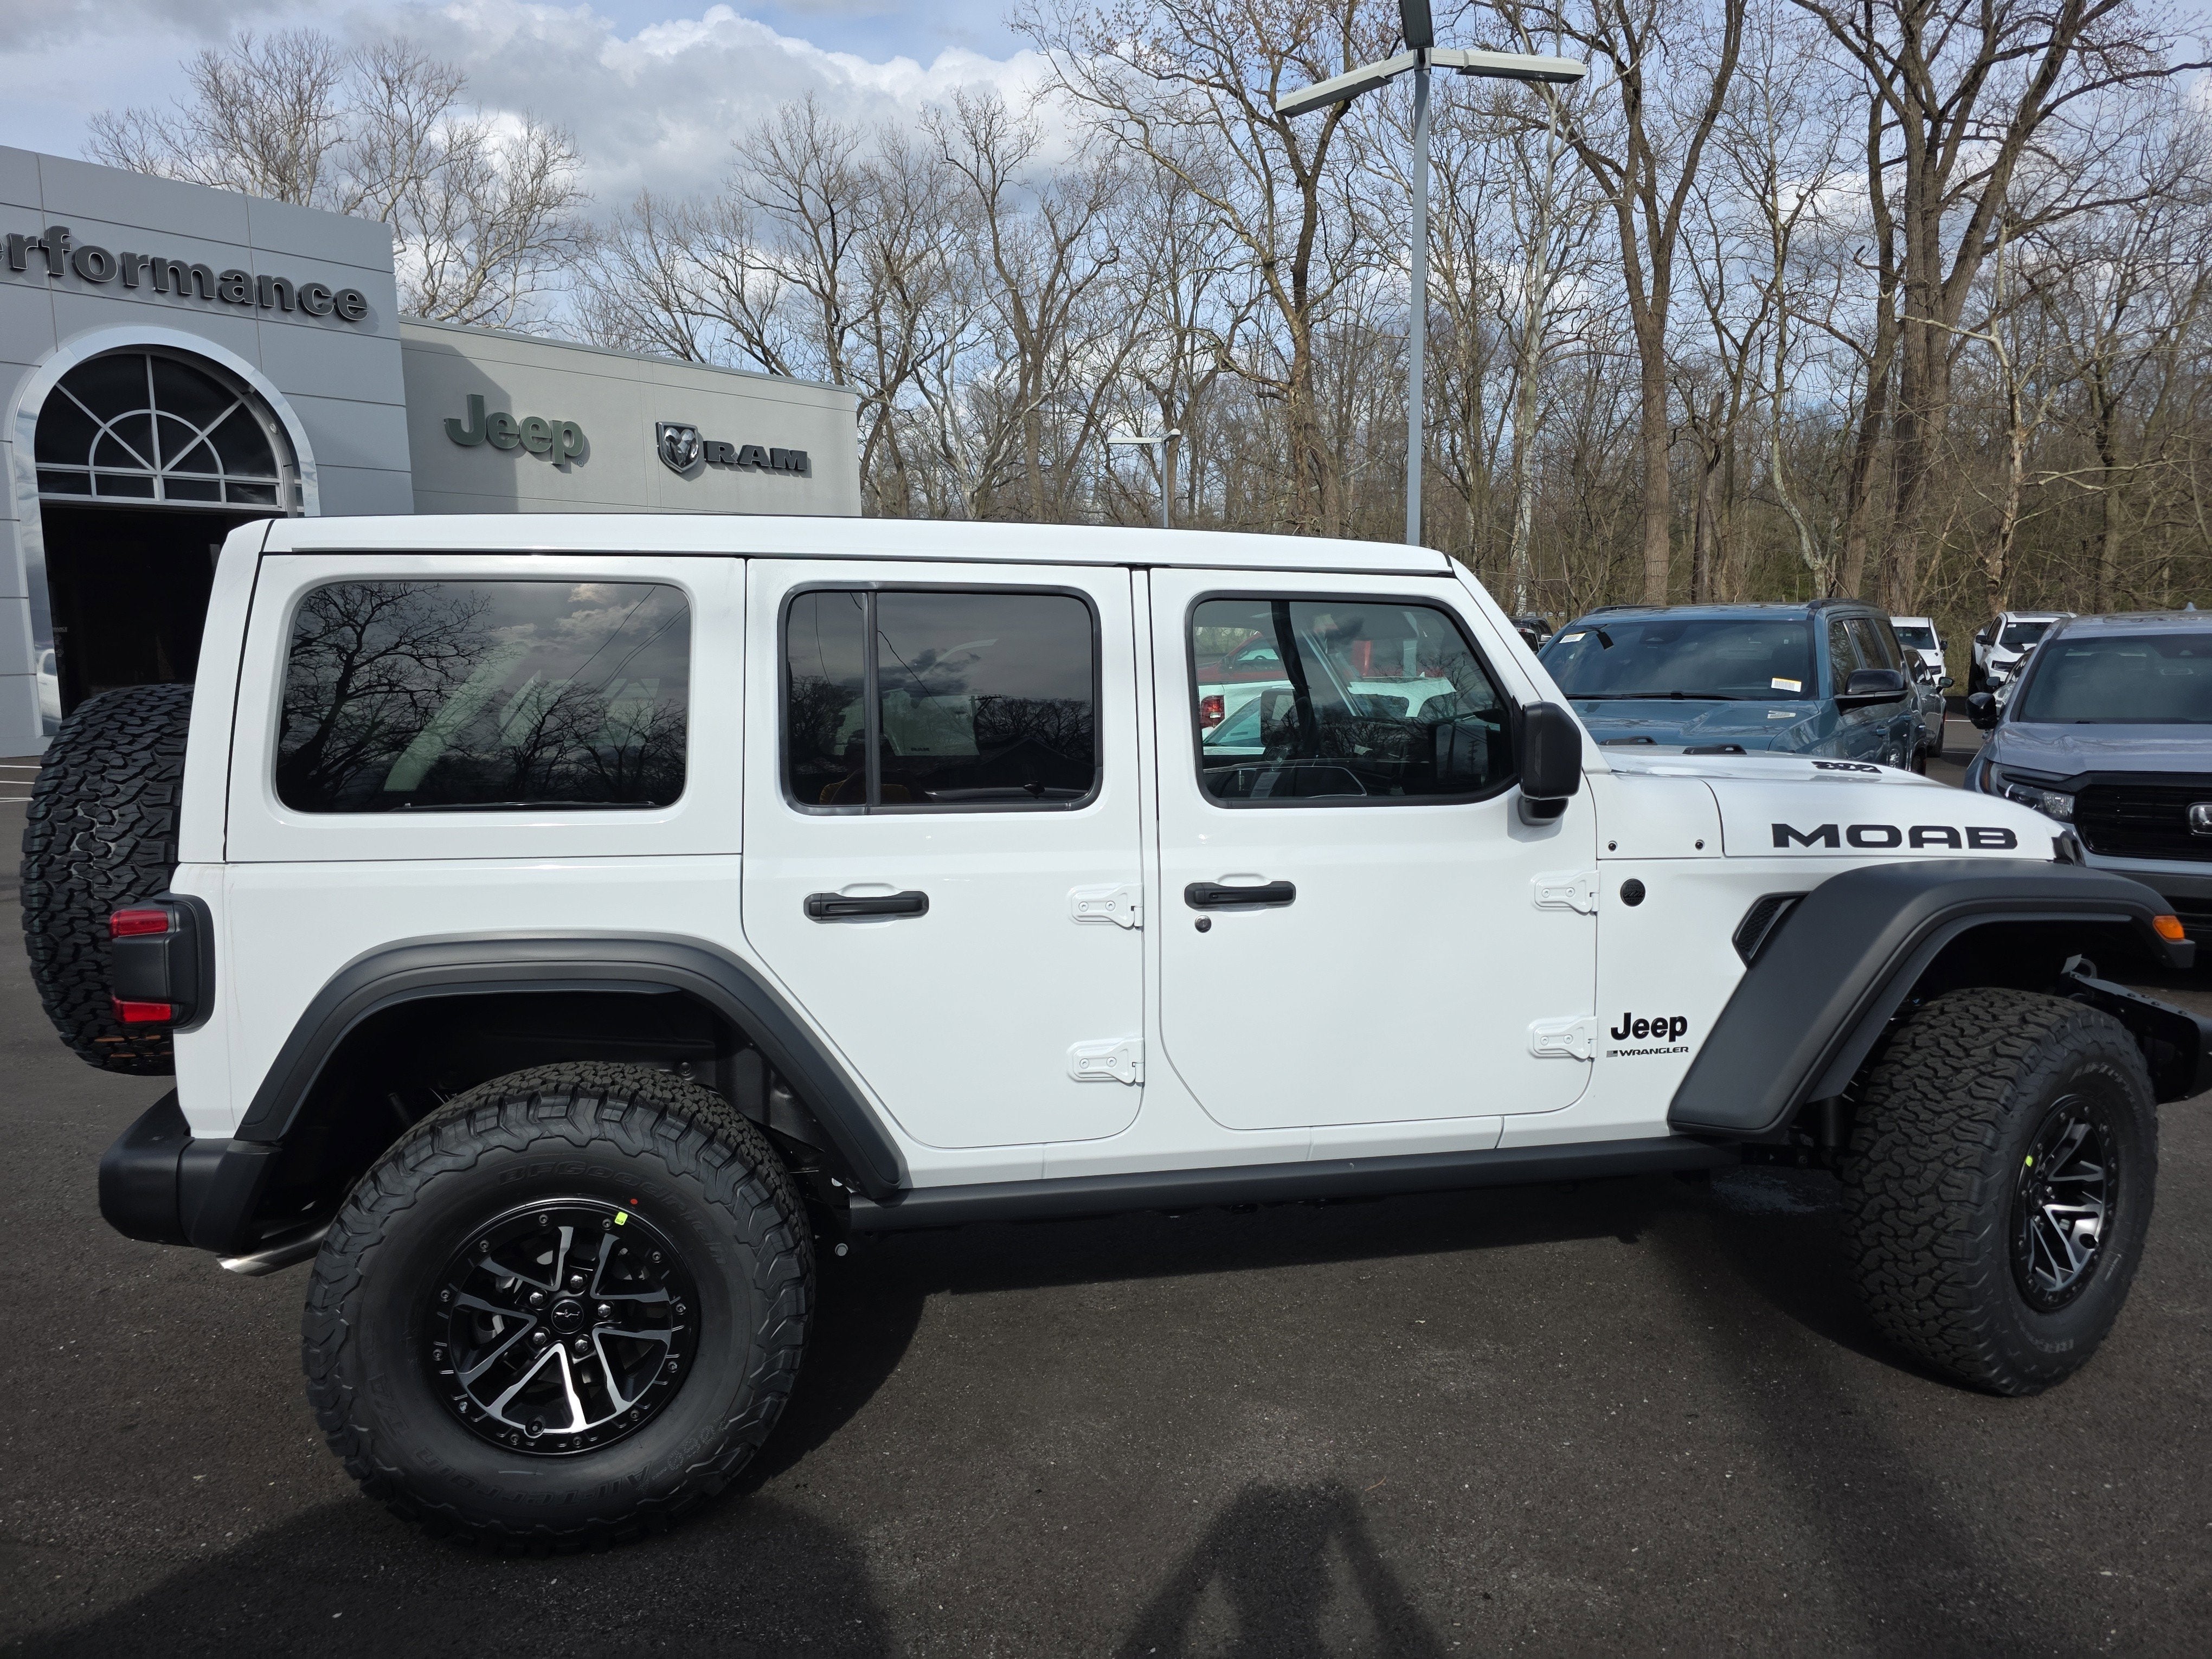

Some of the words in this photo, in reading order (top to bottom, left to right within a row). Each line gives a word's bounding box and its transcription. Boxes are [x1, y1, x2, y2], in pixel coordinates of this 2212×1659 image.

[0, 226, 370, 321] rformance
[444, 394, 584, 465] Jeep
[704, 440, 808, 471] RAM
[1771, 823, 2018, 850] MOAB
[1610, 1012, 1688, 1043] Jeep
[1619, 1046, 1689, 1057] WRANGLER
